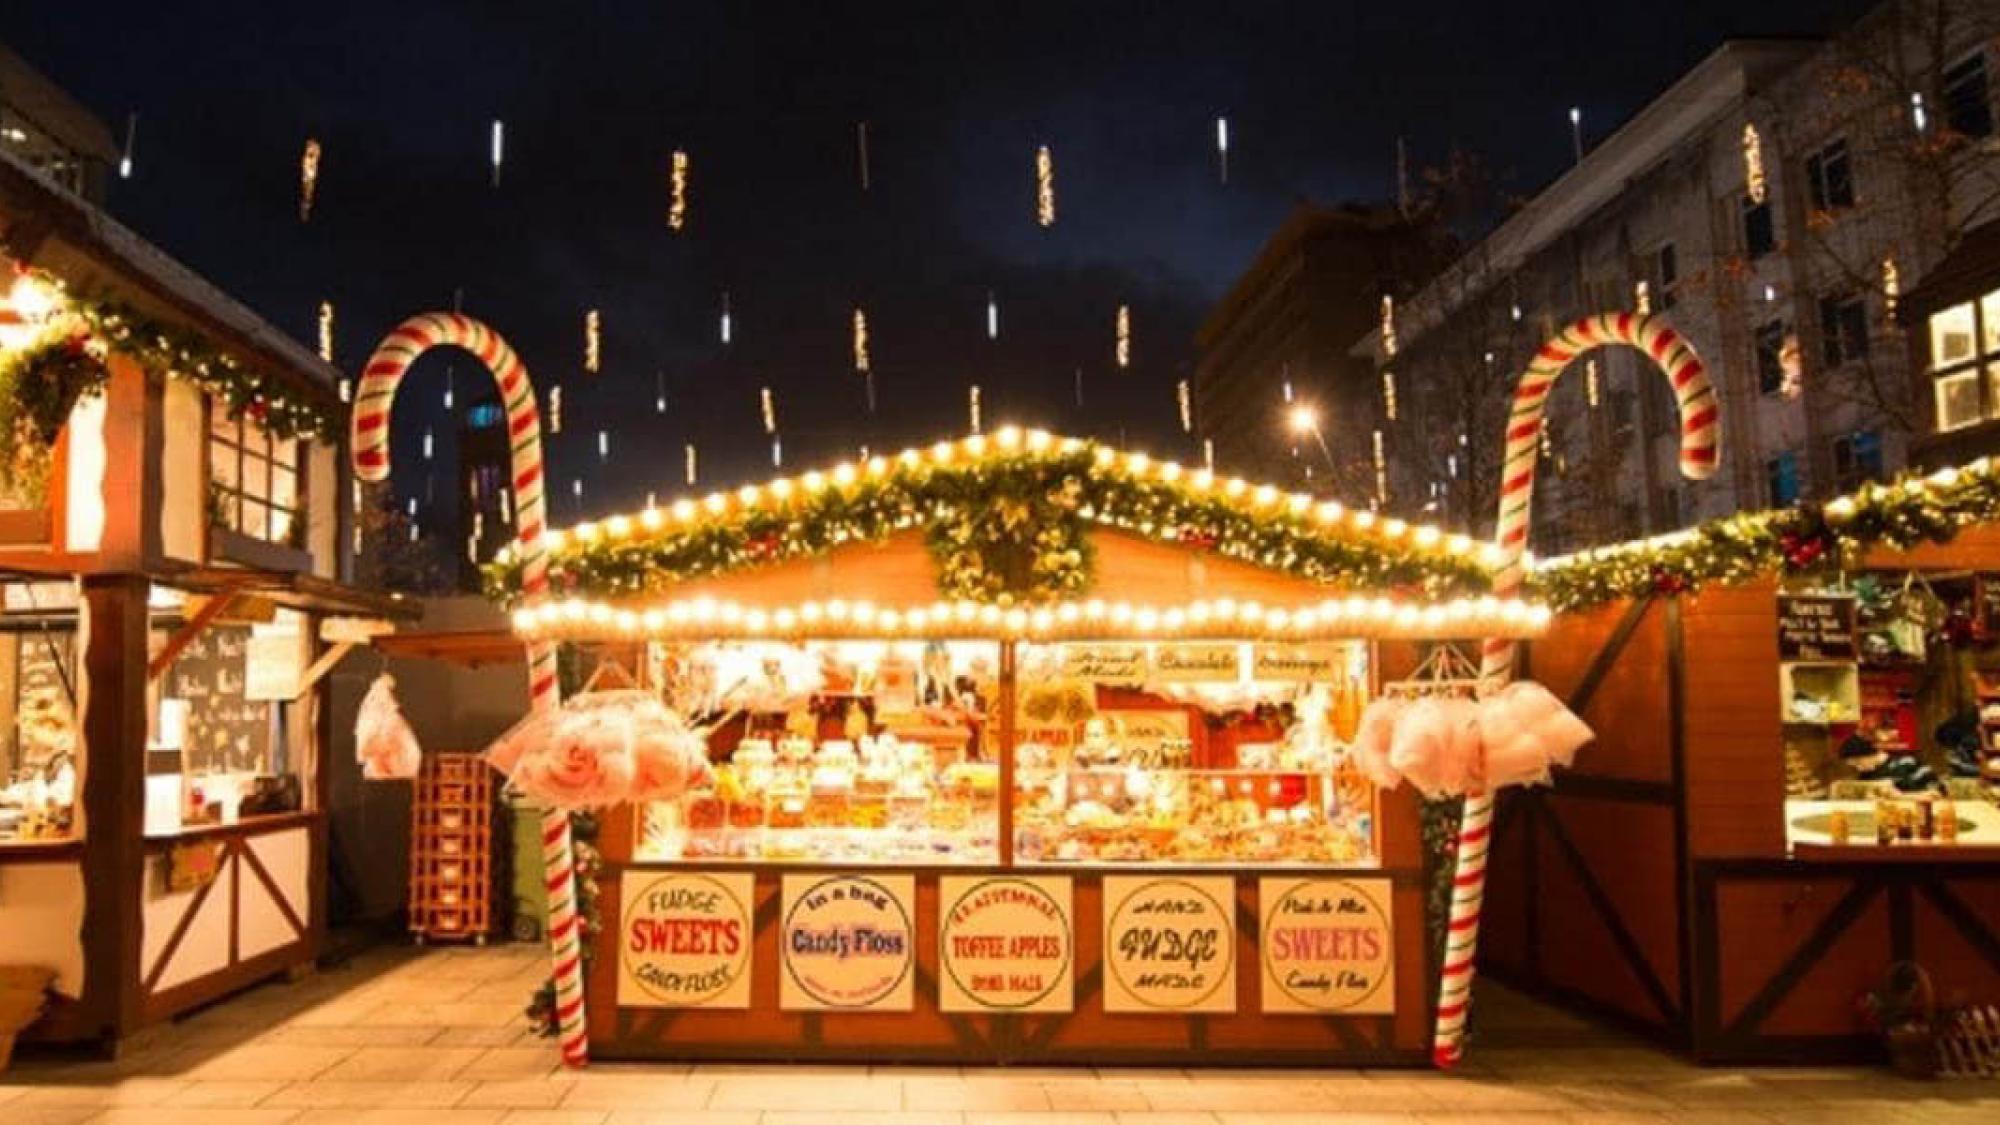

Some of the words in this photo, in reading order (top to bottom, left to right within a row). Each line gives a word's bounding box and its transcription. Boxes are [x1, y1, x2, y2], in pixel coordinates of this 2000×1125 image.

[648, 887, 721, 914] FUDGE
[629, 918, 741, 955] SWEETS
[792, 928, 849, 960] Candy
[853, 928, 905, 954] Floss
[952, 935, 1005, 959] TOFFEE
[1009, 935, 1061, 959] APPLES
[1119, 927, 1219, 971] FUDGE
[1273, 927, 1381, 961] SWEETS
